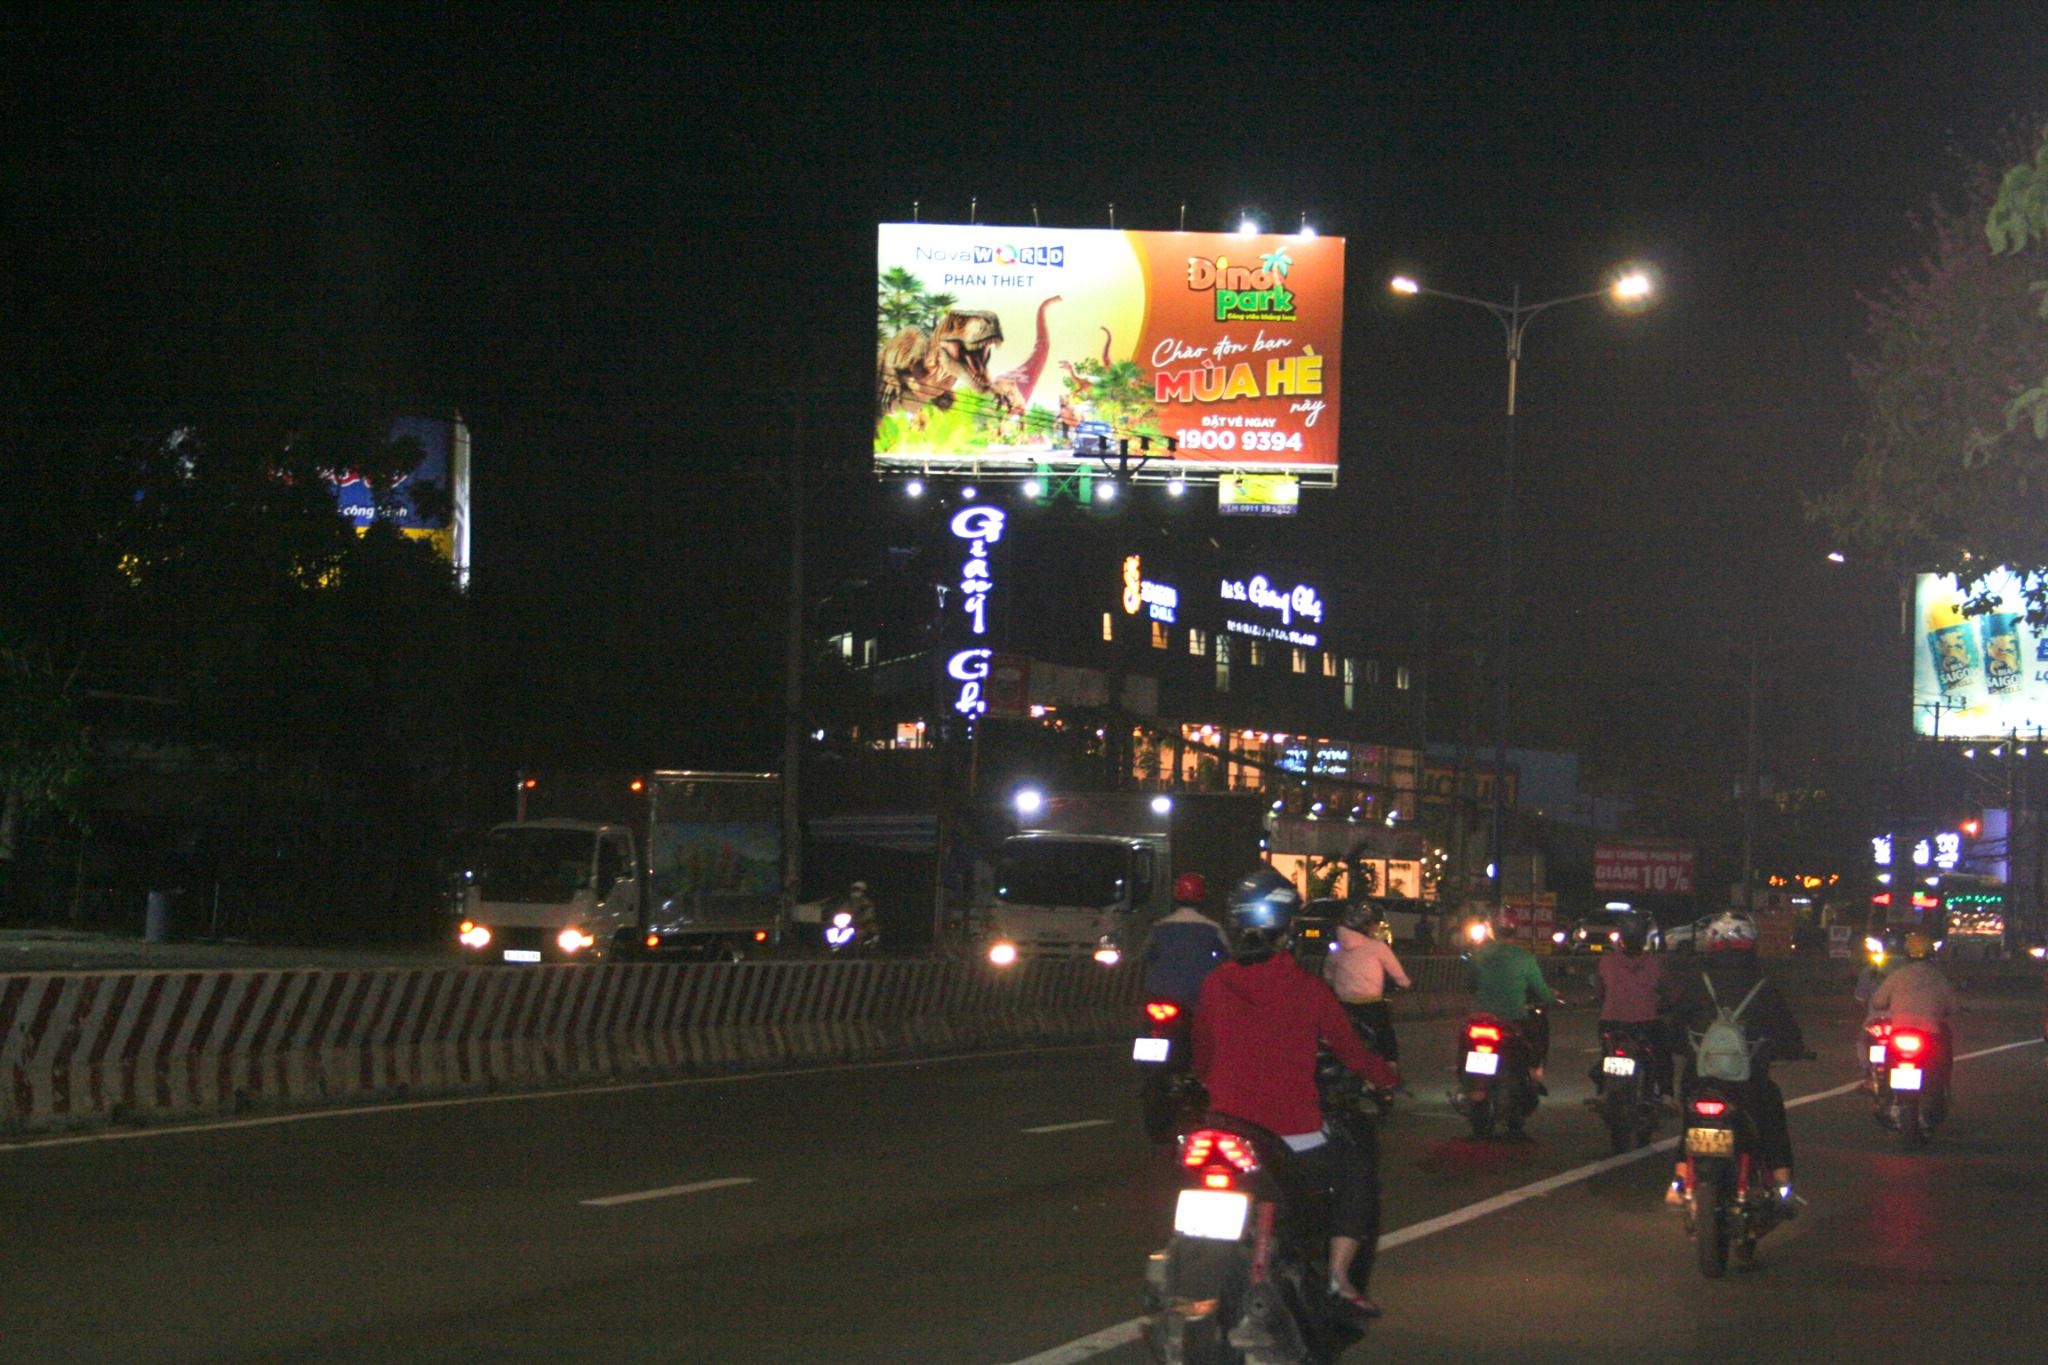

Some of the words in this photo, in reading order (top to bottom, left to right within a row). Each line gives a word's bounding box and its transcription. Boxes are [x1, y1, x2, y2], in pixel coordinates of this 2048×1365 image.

[944, 274, 986, 286] PHAN
[992, 275, 1034, 288] THIET
[1188, 256, 1275, 291] Dino
[1215, 286, 1296, 321] park
[1151, 338, 1208, 367] Chào
[1155, 358, 1260, 403] MÙA
[1265, 344, 1324, 396] HÈ
[1244, 416, 1277, 427] NGAY
[1176, 429, 1236, 450] 1900
[1241, 431, 1303, 452] 9394
[951, 506, 1005, 634] Giang
